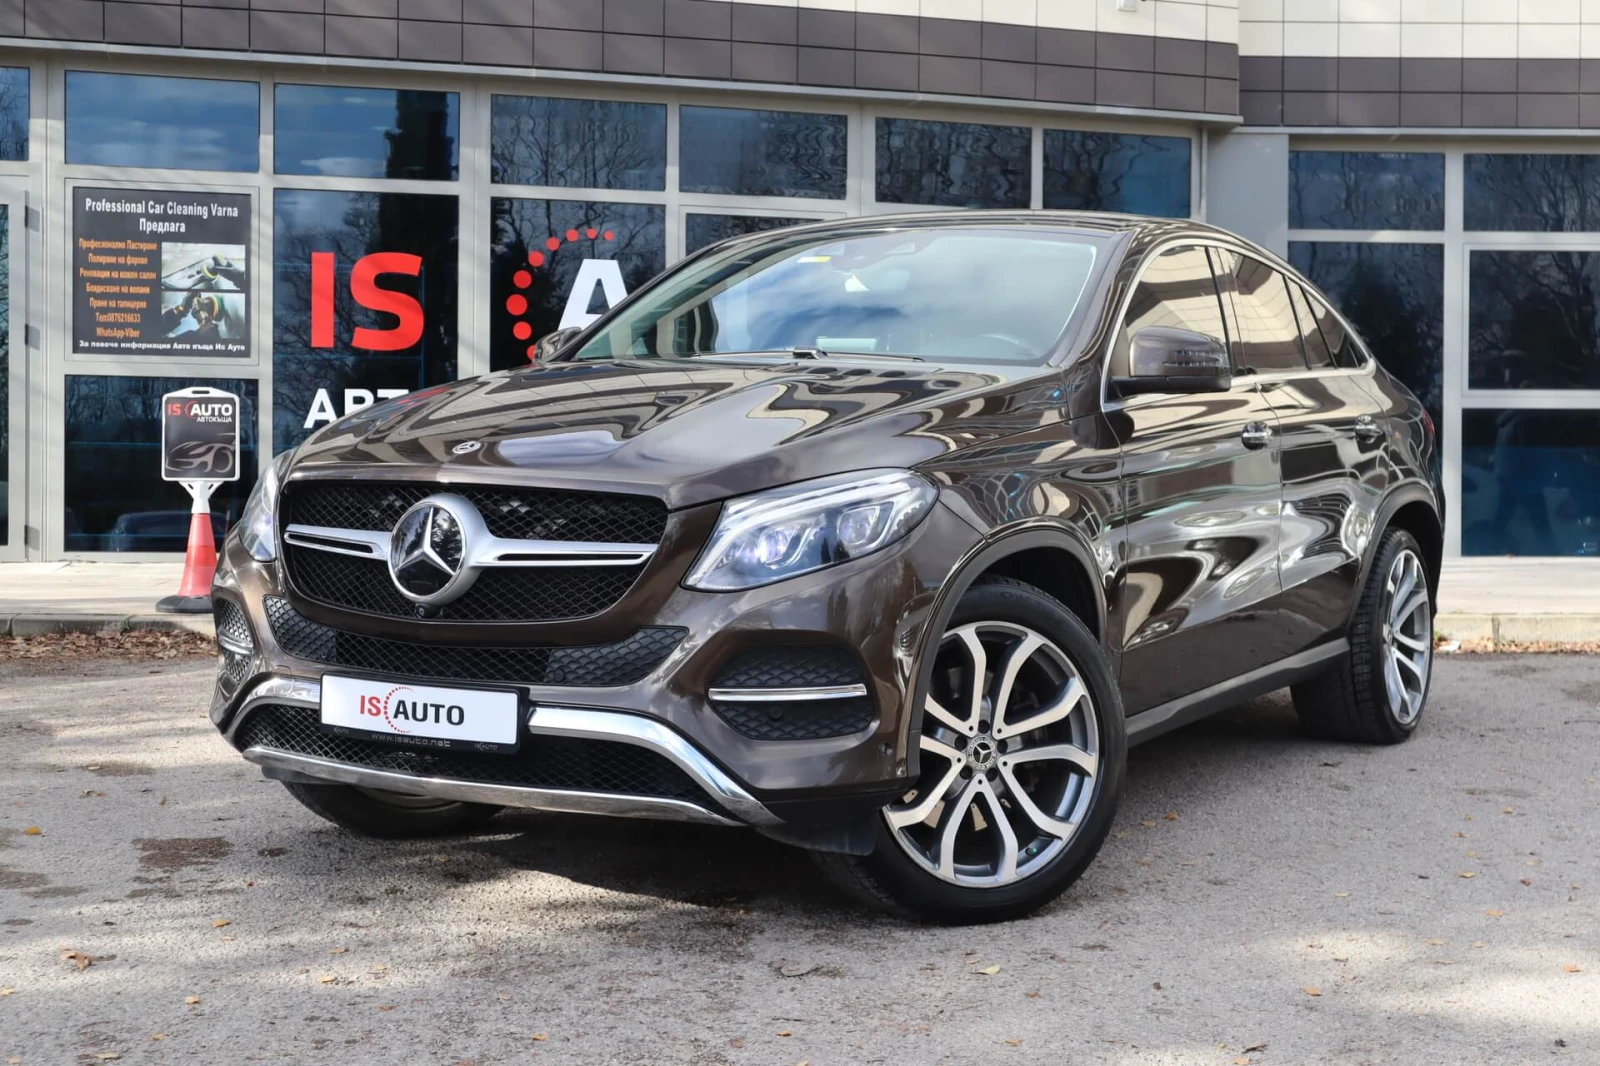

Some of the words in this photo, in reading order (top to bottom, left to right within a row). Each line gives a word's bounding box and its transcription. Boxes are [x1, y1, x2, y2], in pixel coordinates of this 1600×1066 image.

[85, 198, 145, 214] Professional
[148, 201, 164, 214] Car
[167, 201, 207, 219] Cleaning
[211, 203, 238, 217] Varna
[139, 218, 185, 233] Предлага
[311, 252, 424, 351] IS
[120, 341, 171, 350] информация
[227, 344, 245, 352] Ауто
[168, 403, 181, 416] IS
[190, 403, 232, 416] AUTO
[360, 695, 381, 717] IS
[393, 699, 465, 726] AUTO
[371, 733, 450, 747] www.isauto.net
